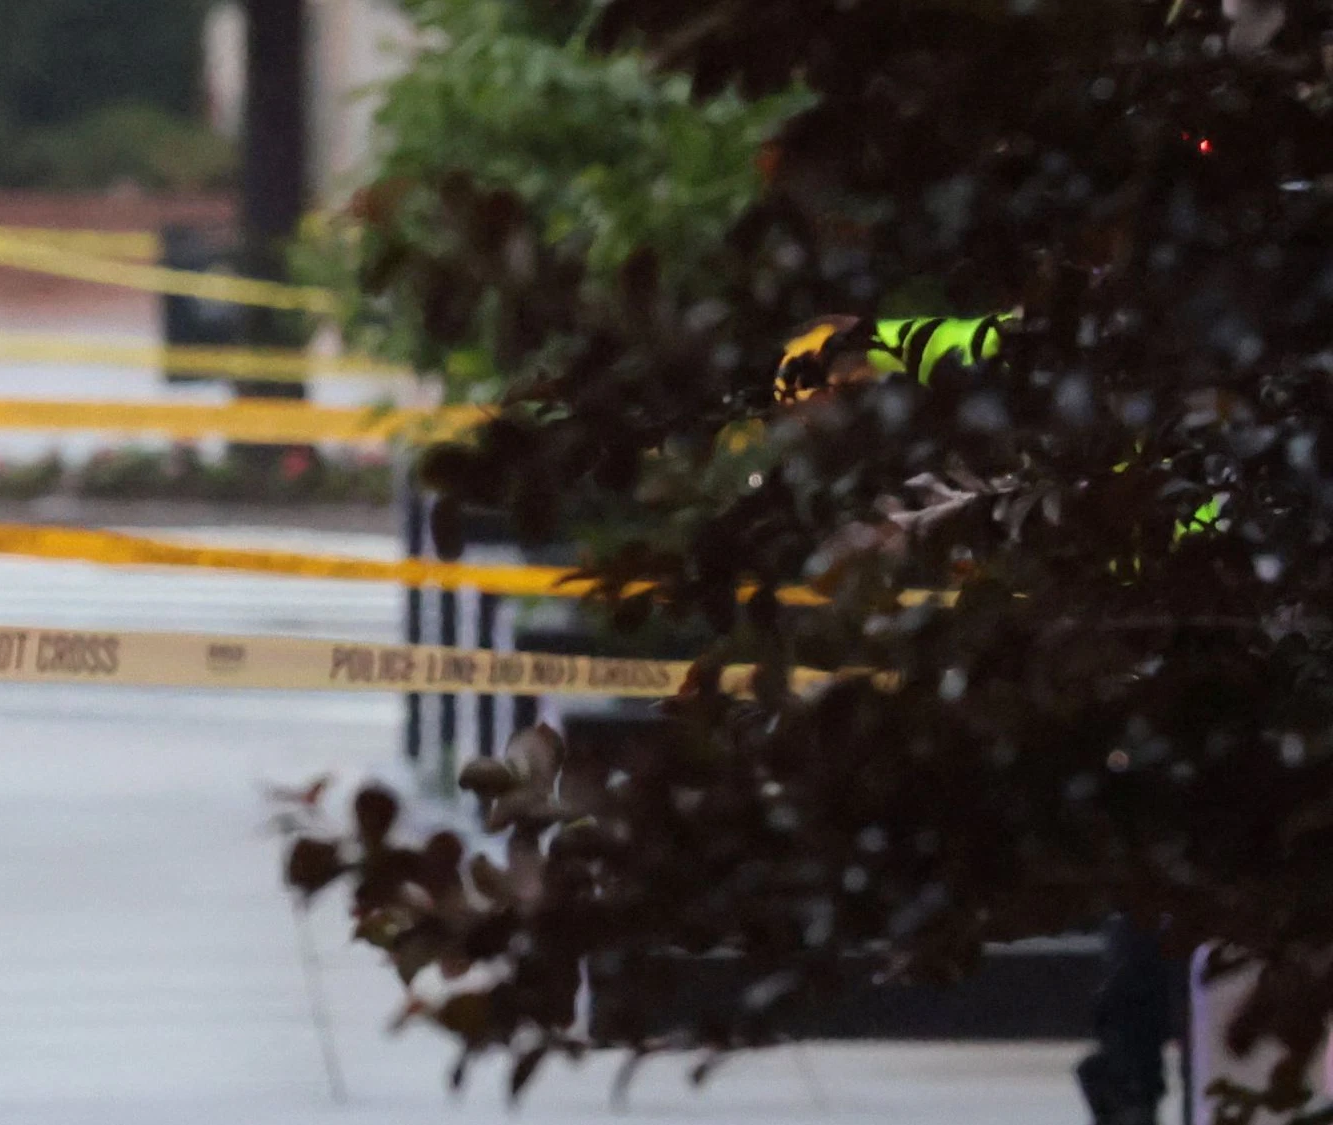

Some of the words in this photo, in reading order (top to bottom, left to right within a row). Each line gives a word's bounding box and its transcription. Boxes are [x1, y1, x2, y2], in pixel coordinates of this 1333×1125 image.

[35, 632, 120, 675] CROSS
[330, 645, 415, 684] POLICE
[426, 650, 476, 685] LINE
[489, 653, 525, 686] DO
[533, 654, 579, 688] NOT
[588, 657, 672, 690] CROSS
